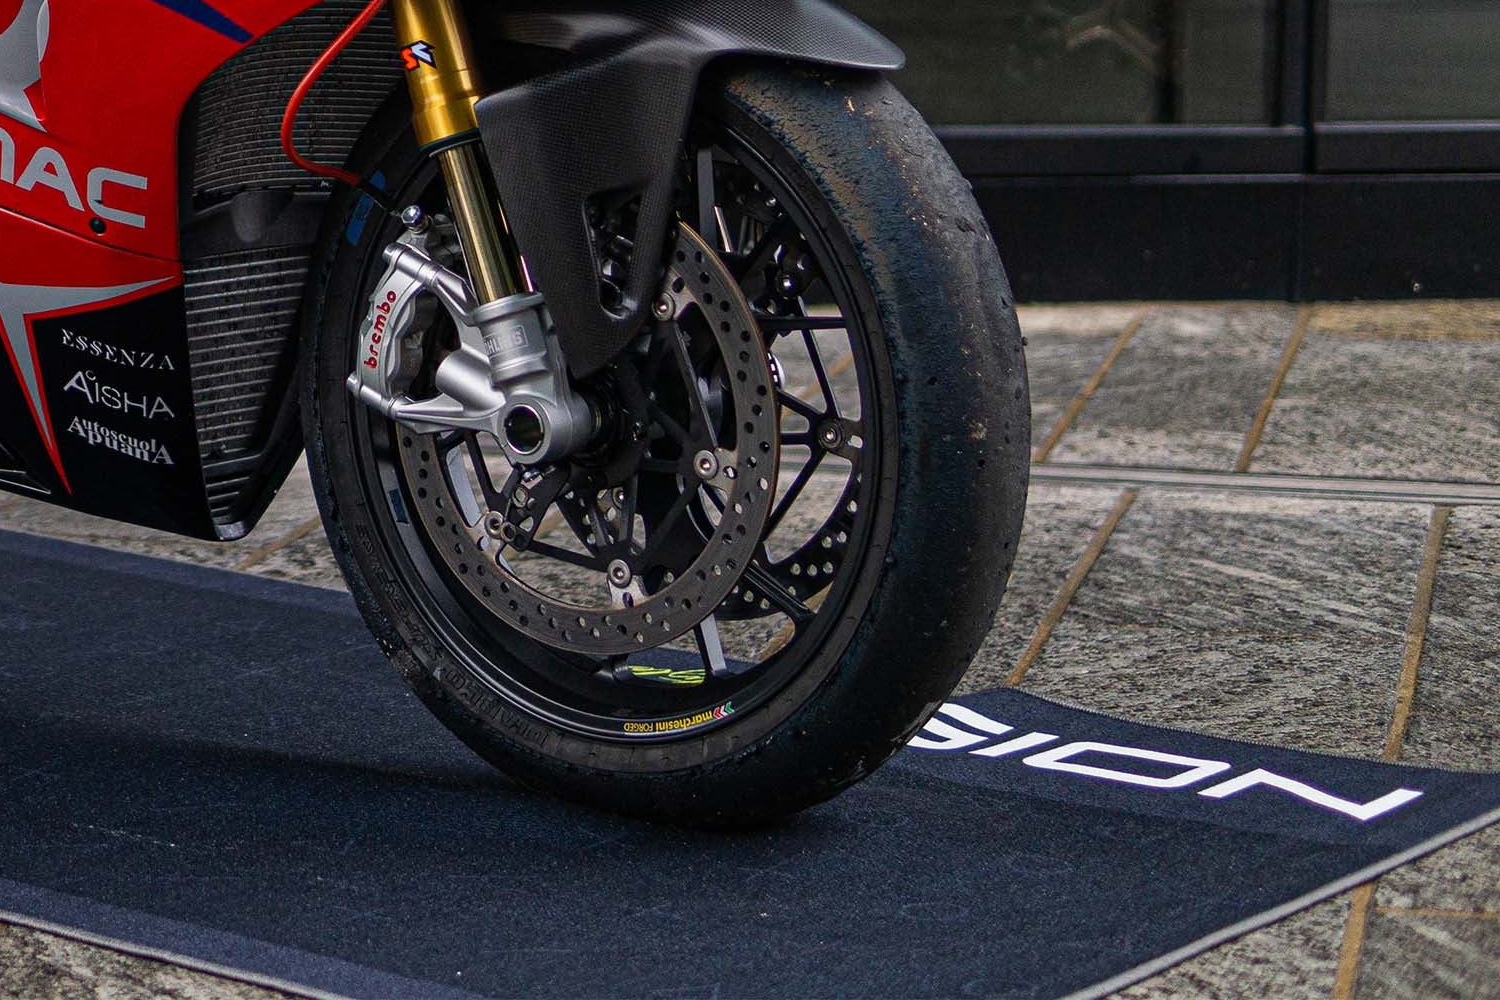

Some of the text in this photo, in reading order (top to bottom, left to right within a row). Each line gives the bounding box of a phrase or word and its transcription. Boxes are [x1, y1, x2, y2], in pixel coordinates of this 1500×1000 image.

[61, 327, 175, 371] ESSENZA
[364, 290, 397, 369] brembo
[623, 709, 713, 733] marchesini FORGED
